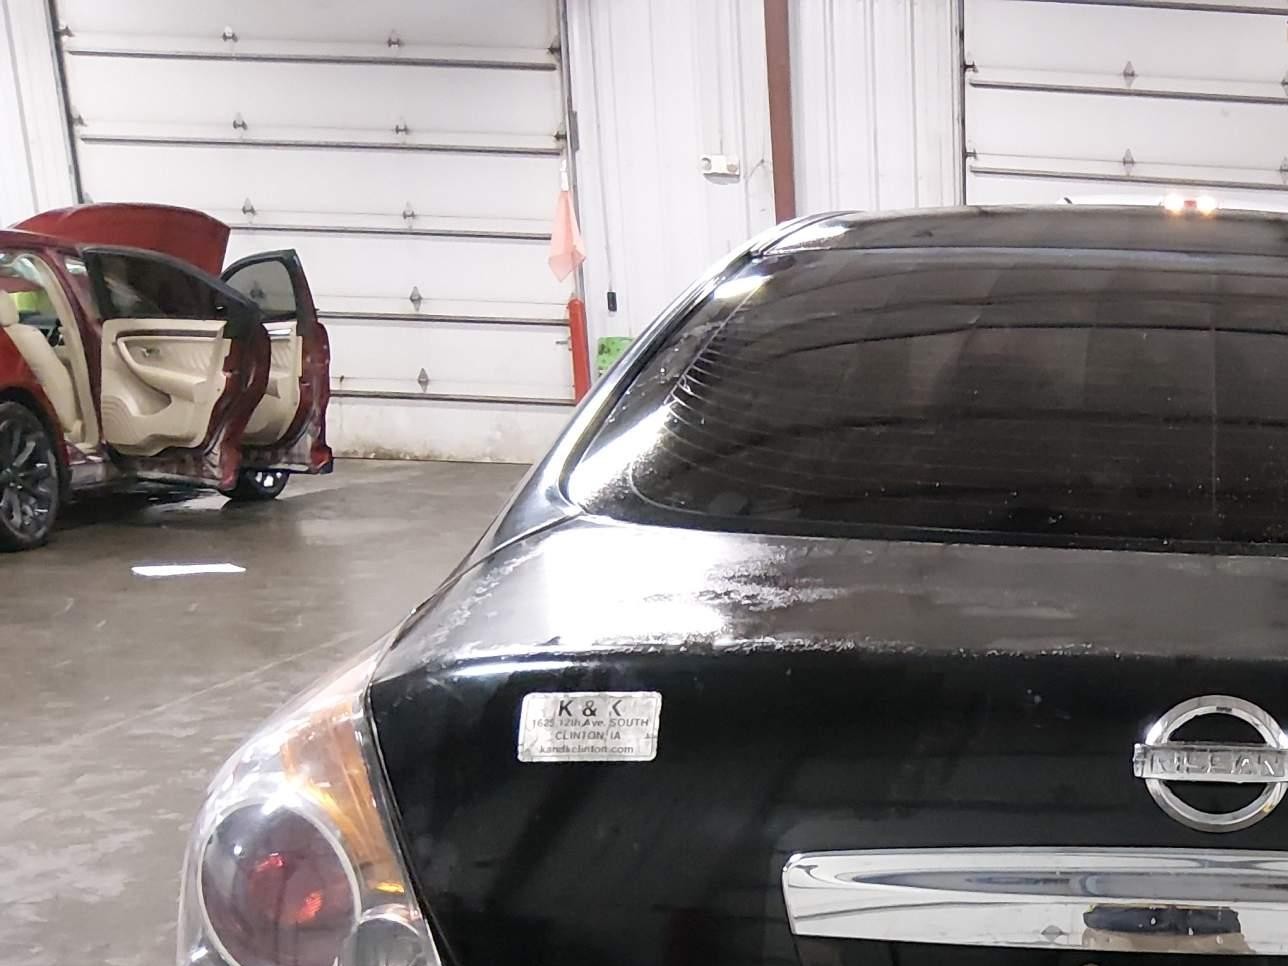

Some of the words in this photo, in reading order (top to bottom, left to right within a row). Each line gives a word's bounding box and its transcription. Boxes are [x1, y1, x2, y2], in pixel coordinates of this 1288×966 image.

[559, 699, 573, 716] K
[582, 700, 597, 717] &
[608, 718, 649, 727] SOUTH
[610, 731, 621, 740] IA
[1150, 749, 1285, 777] NISSAN
